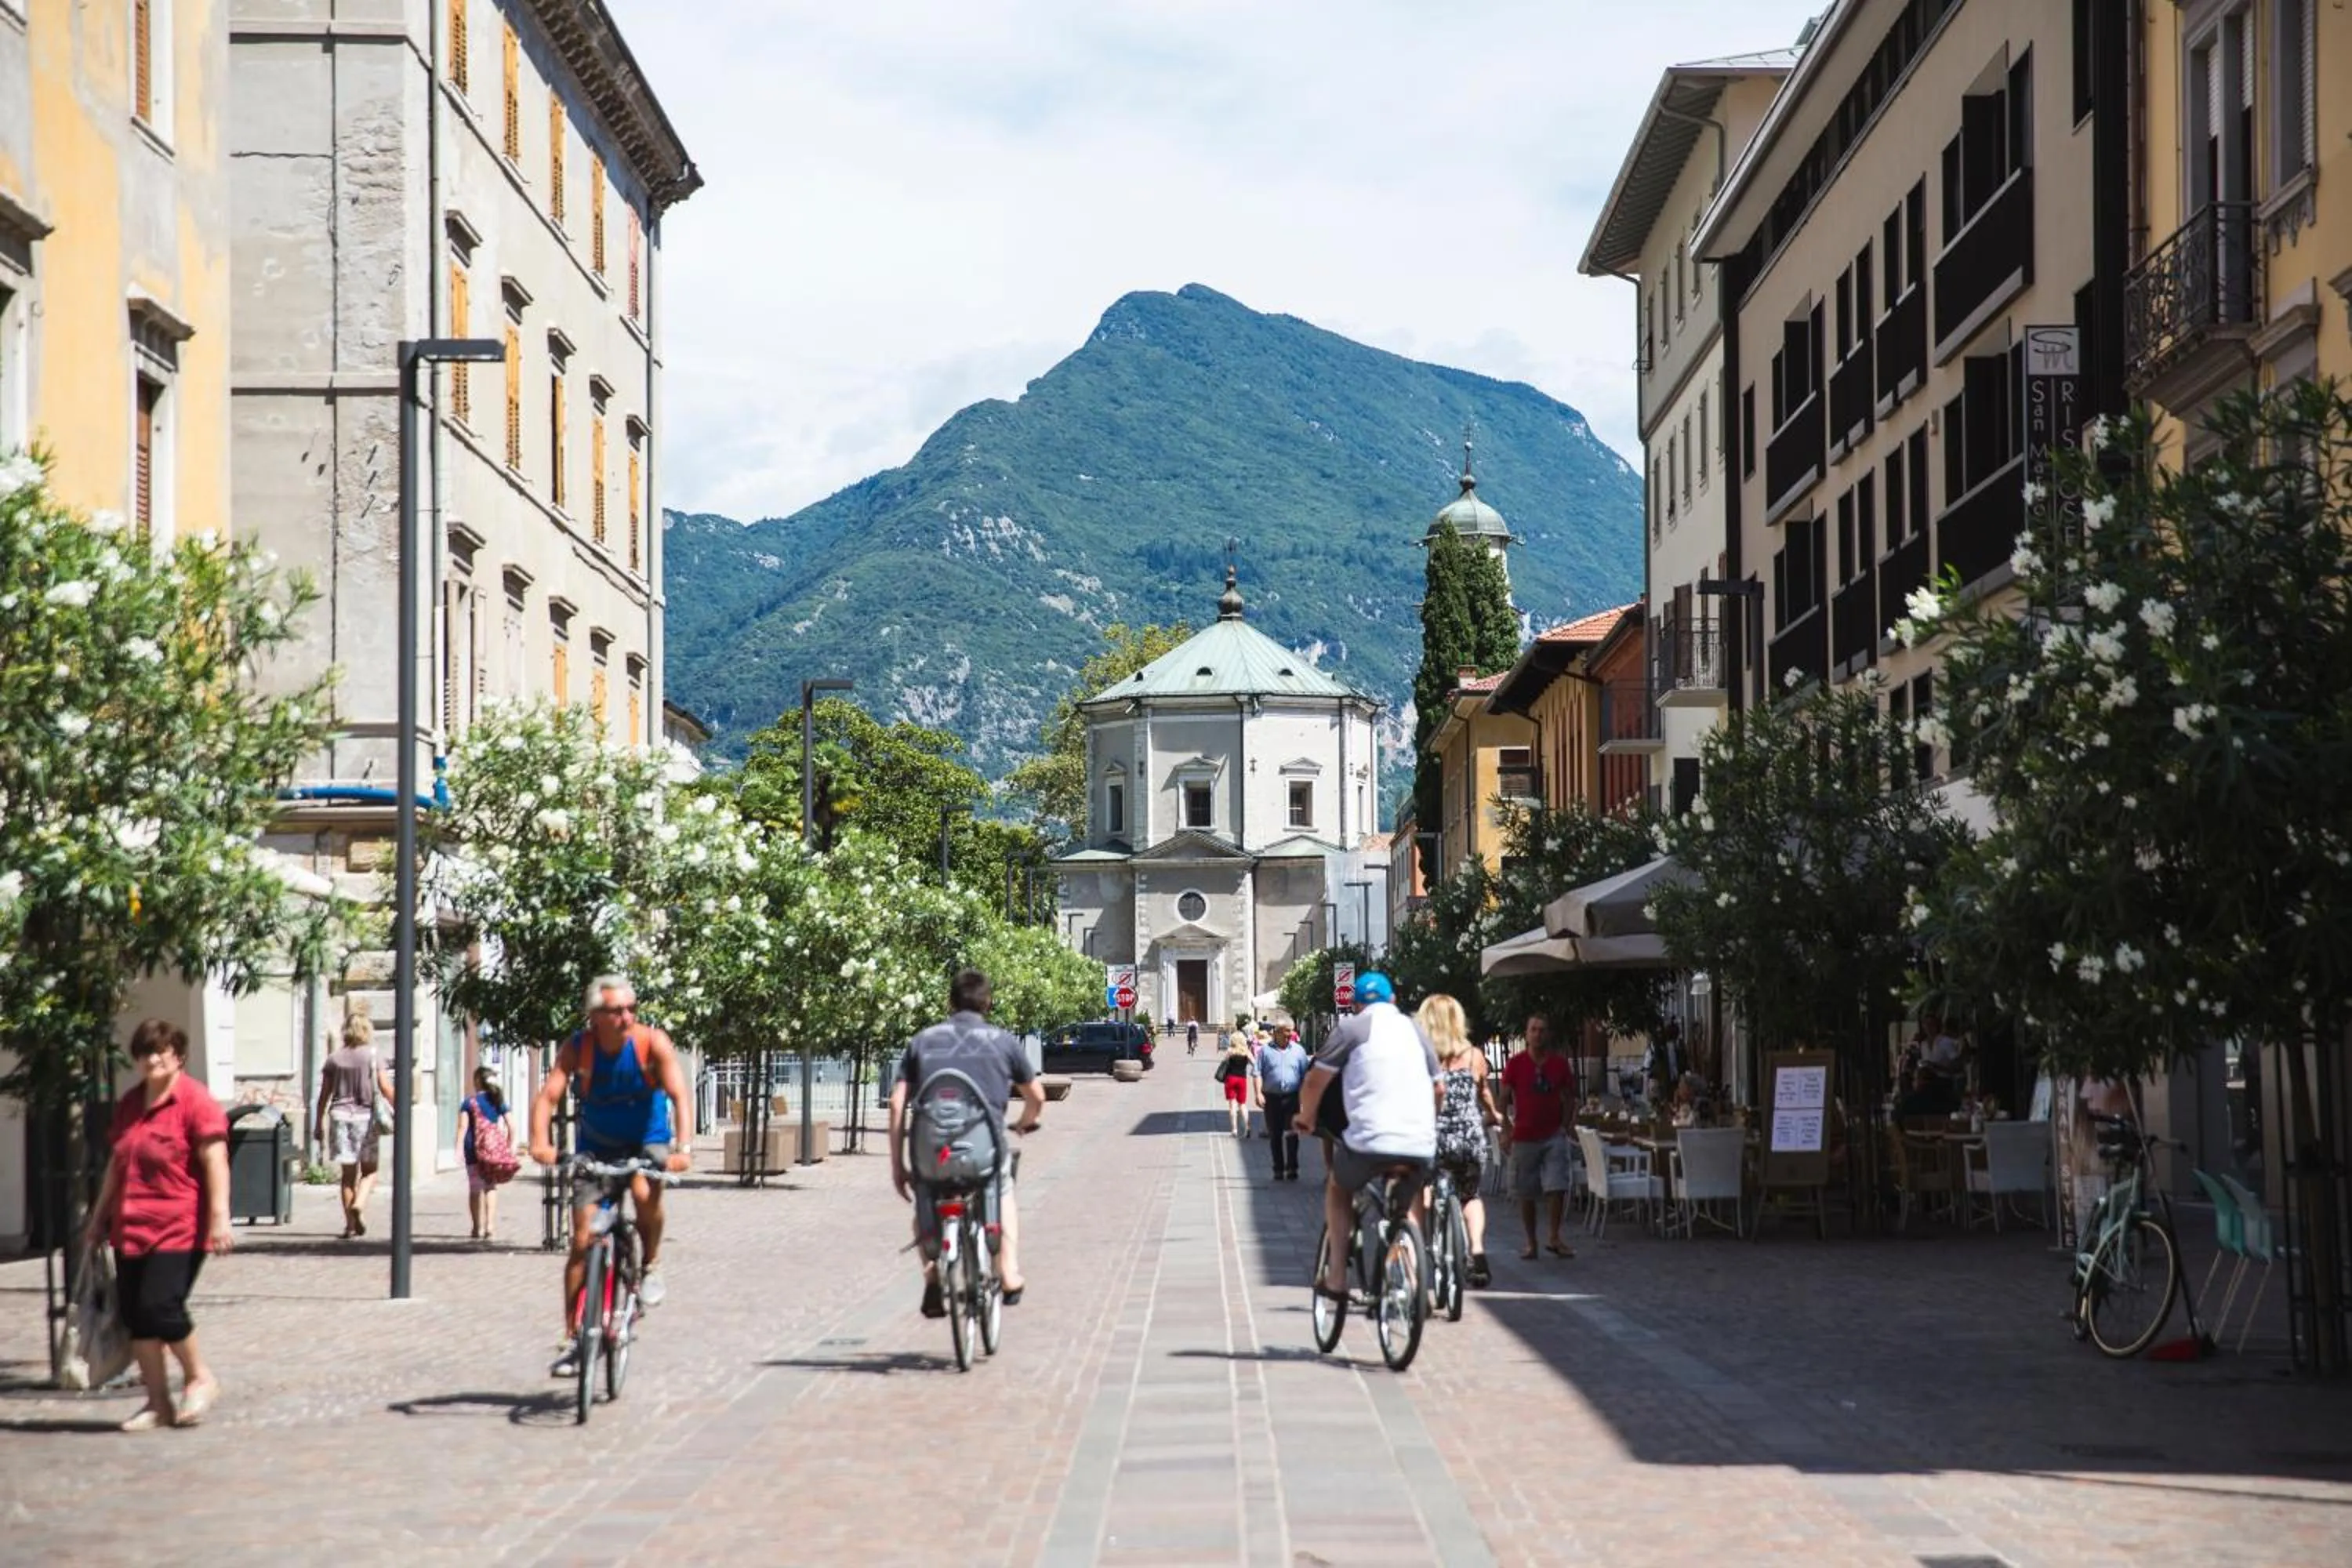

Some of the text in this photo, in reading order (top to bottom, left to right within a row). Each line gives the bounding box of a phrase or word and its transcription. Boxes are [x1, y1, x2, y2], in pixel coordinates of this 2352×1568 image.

[2031, 379, 2045, 431] San
[2030, 442, 2048, 517] Maro
[1116, 993, 1134, 1003] STOP
[2060, 1163, 2074, 1247] STYLE
